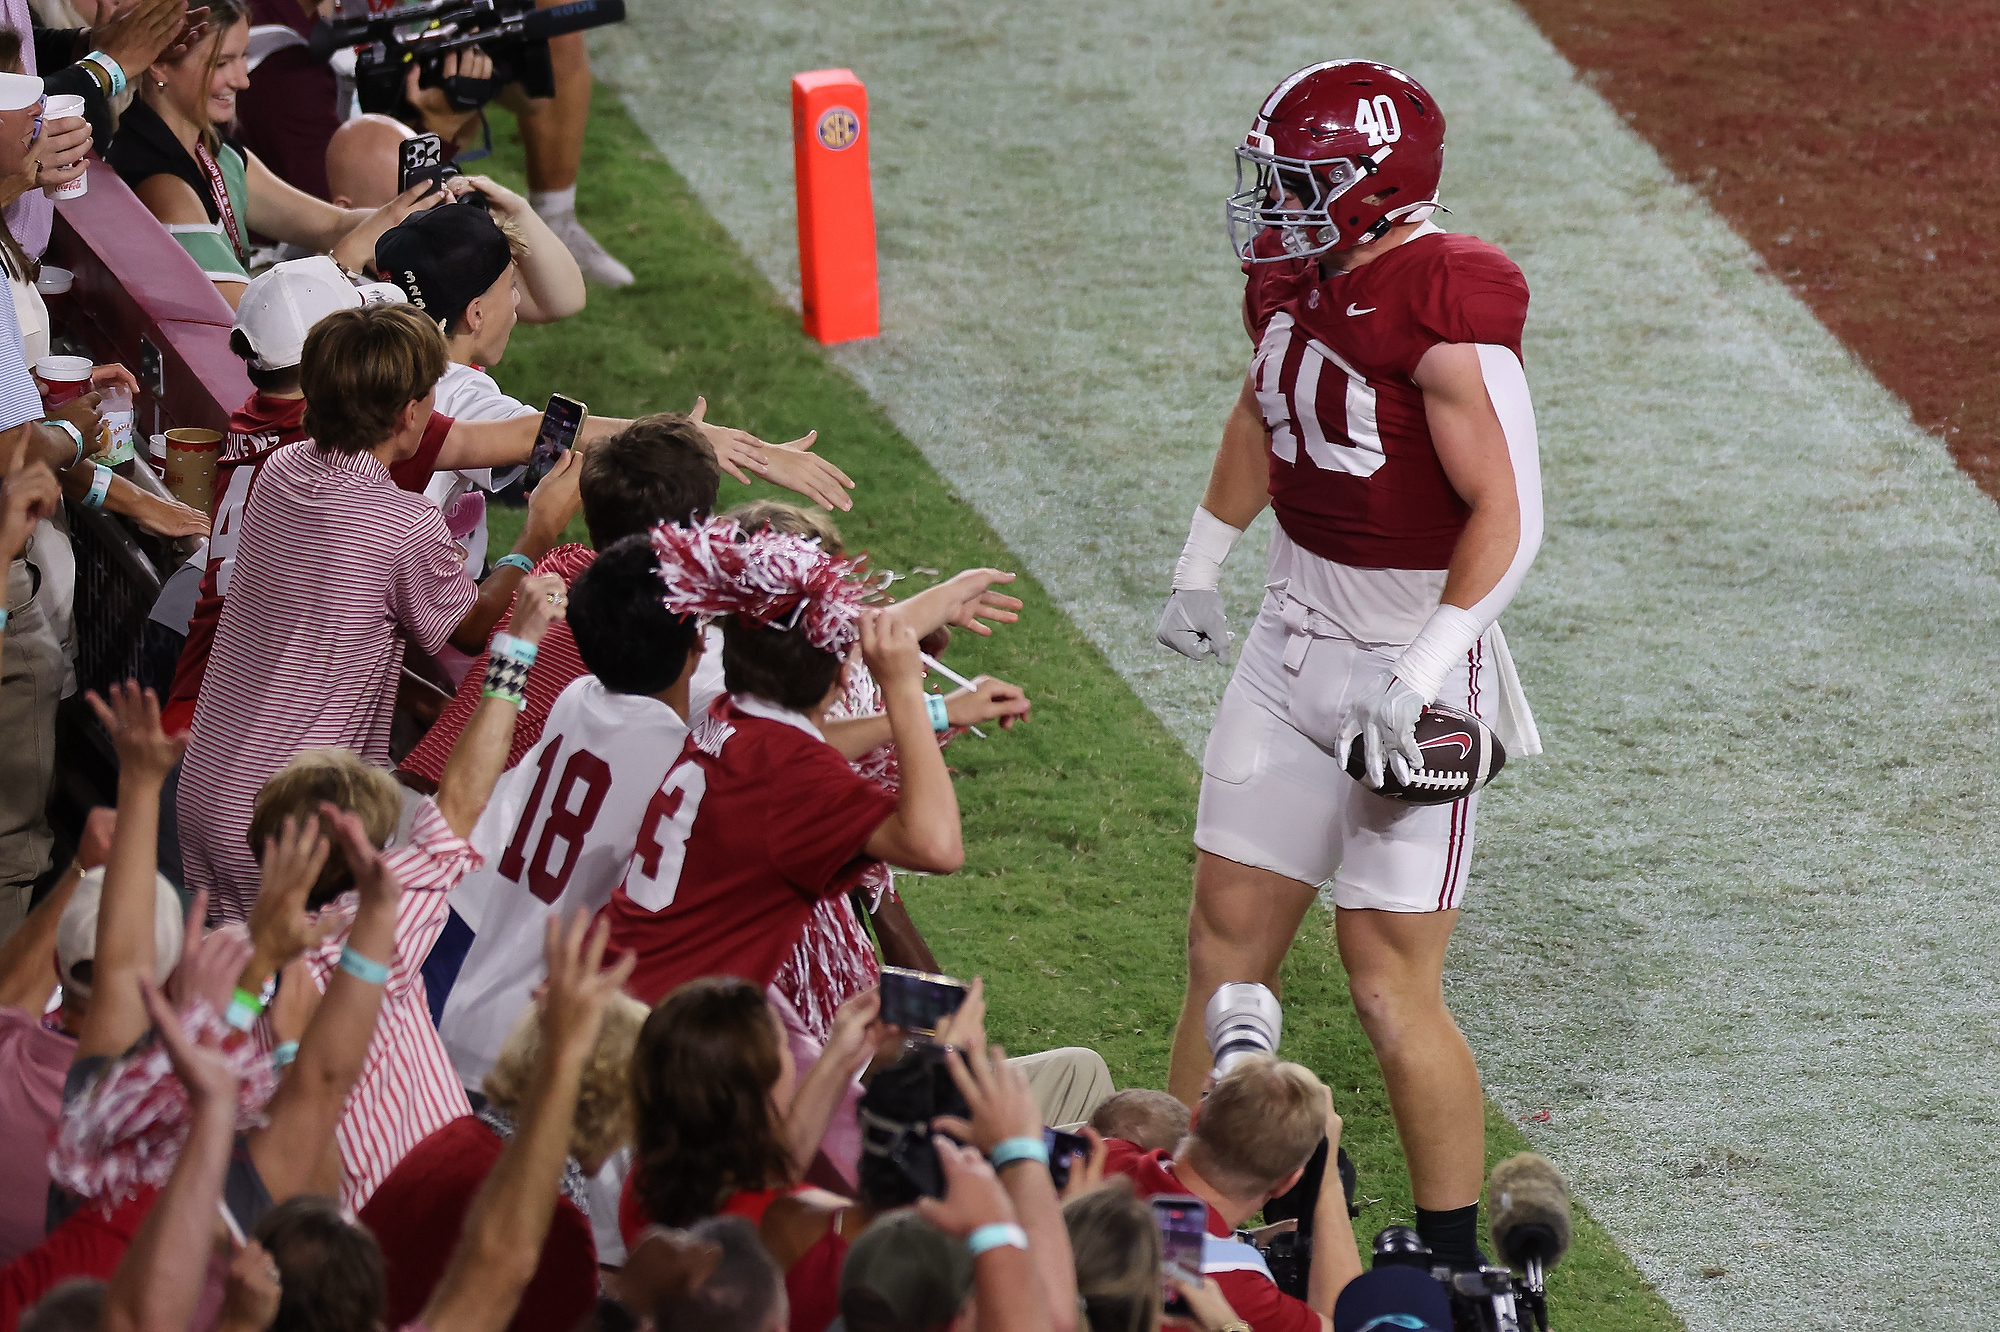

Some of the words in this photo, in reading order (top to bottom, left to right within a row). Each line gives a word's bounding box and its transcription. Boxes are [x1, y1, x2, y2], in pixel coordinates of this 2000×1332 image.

[196, 142, 220, 176] CRIMSON
[216, 175, 226, 196] TIDE
[823, 113, 854, 147] SEC
[1354, 94, 1402, 146] 40
[1250, 311, 1387, 478] 40
[210, 465, 256, 597] 4
[497, 733, 613, 906] 18
[625, 759, 707, 914] 3
